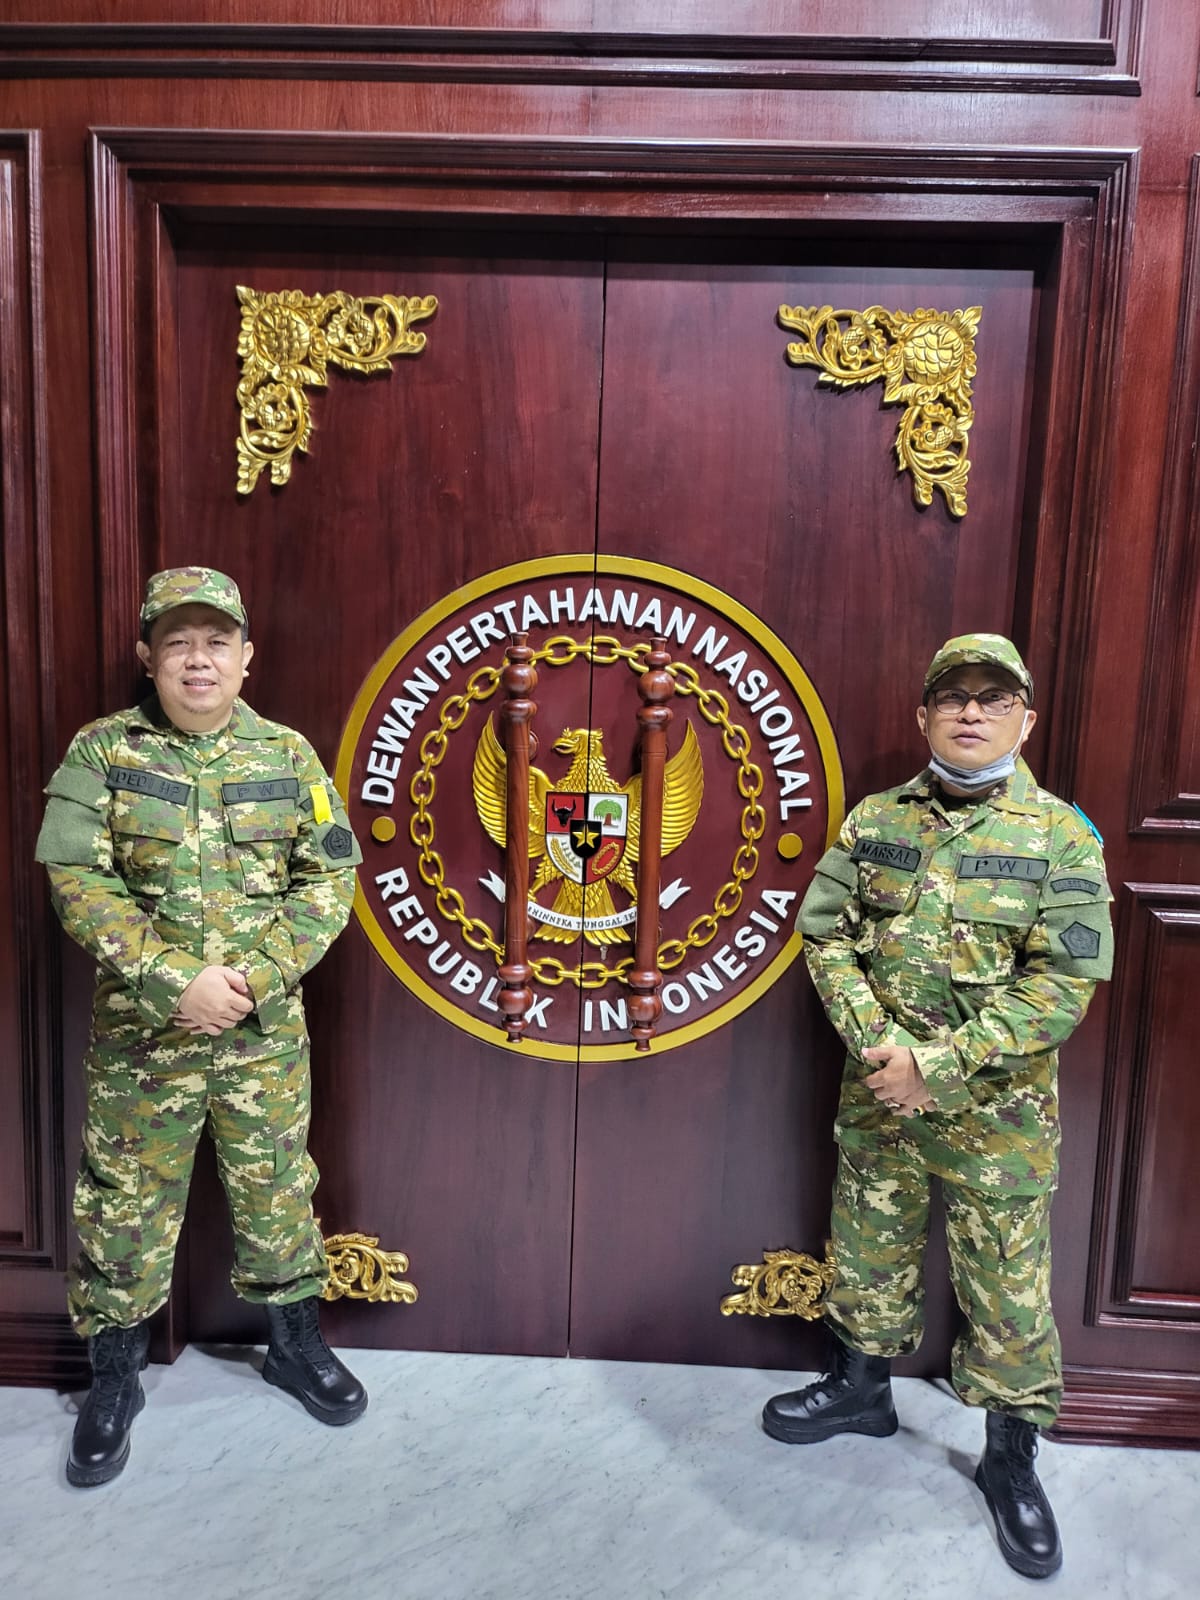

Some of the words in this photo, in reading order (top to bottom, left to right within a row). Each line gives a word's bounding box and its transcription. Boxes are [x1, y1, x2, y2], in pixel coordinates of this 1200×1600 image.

[361, 667, 440, 805] DEWAN
[425, 586, 697, 680] PERTAHANAN
[692, 625, 813, 821] NASIONAL
[860, 842, 910, 865] MARSAL
[375, 867, 554, 1028] REPUBLK
[584, 889, 797, 1032] INONESIA
[576, 917, 622, 929] TUNGGAL
